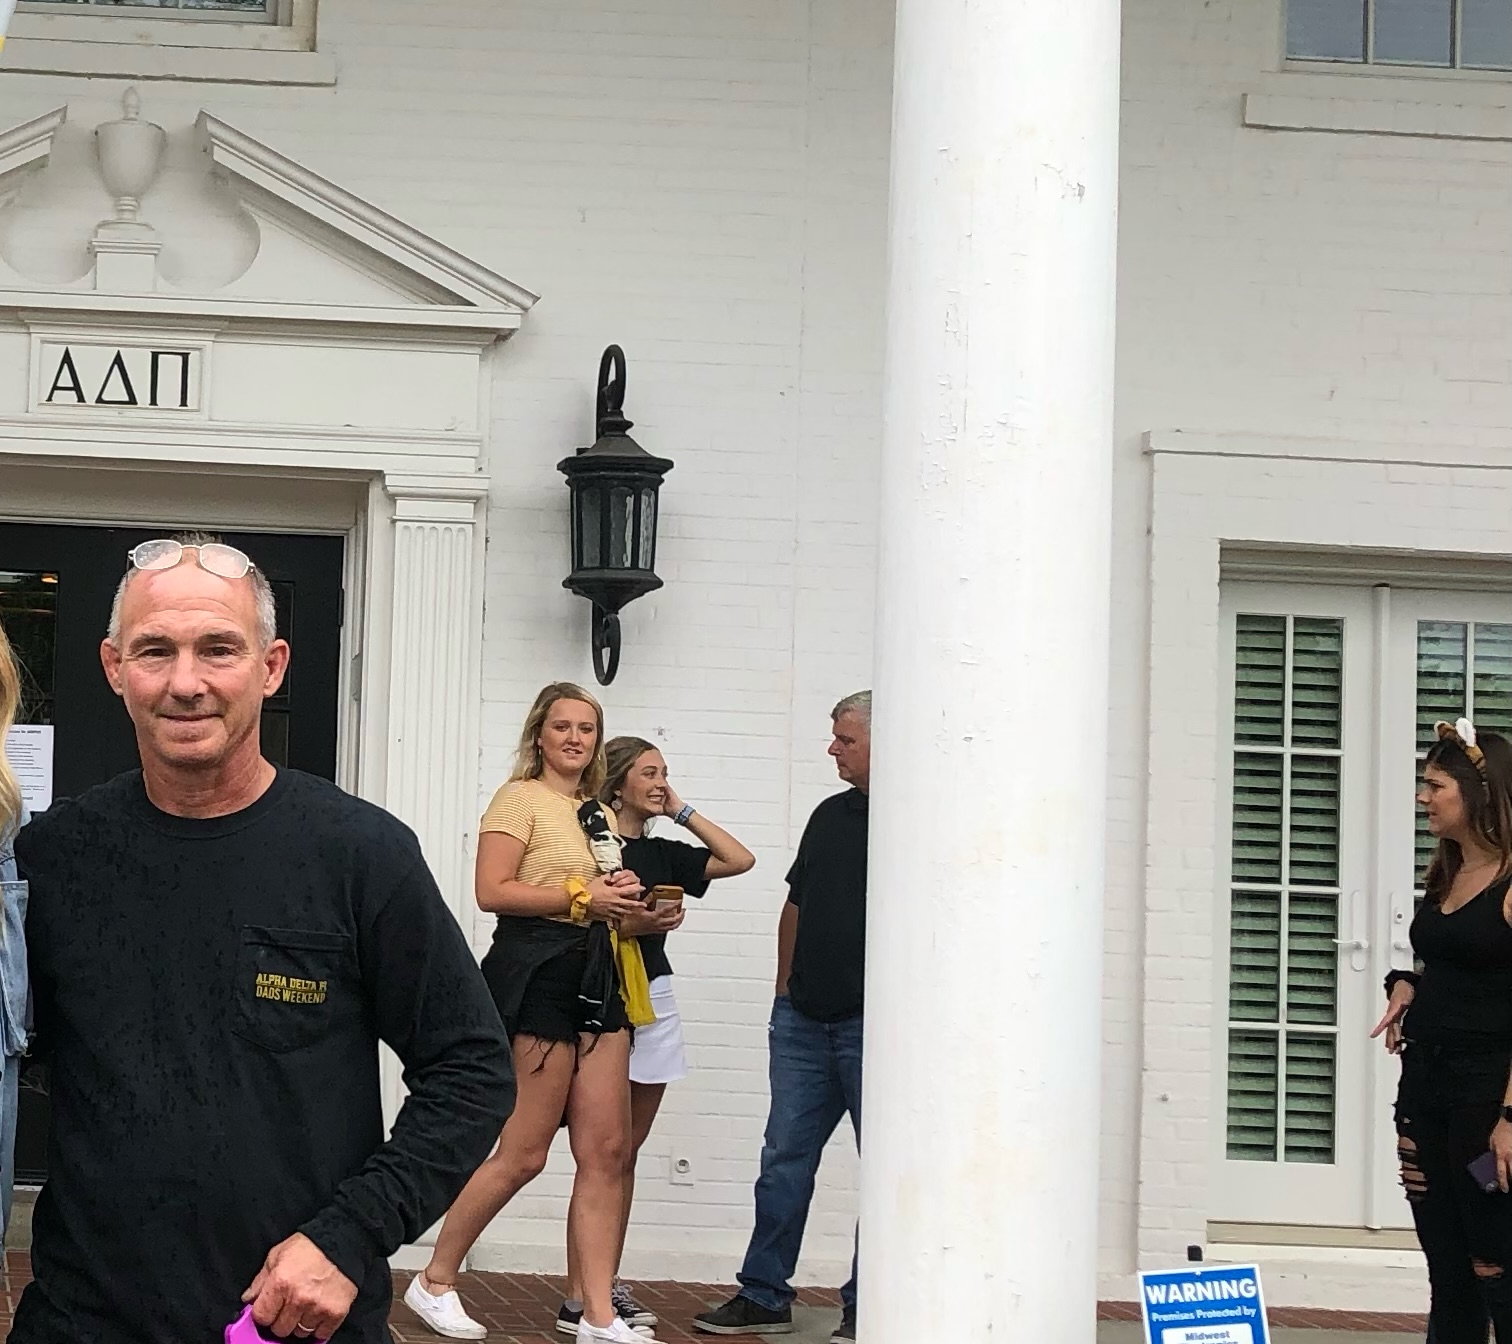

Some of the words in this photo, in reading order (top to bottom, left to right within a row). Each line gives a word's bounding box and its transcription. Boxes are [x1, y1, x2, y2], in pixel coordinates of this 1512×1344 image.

[256, 973, 286, 987] ALPHA
[290, 978, 316, 990] DELTA
[256, 986, 281, 1000] DADS
[283, 990, 326, 1003] WEEKEND
[1145, 1278, 1256, 1305] WARNING
[1151, 1311, 1195, 1322] Premises
[1196, 1305, 1242, 1319] Protected
[1242, 1304, 1256, 1318] by
[1185, 1330, 1230, 1341] Midwest
